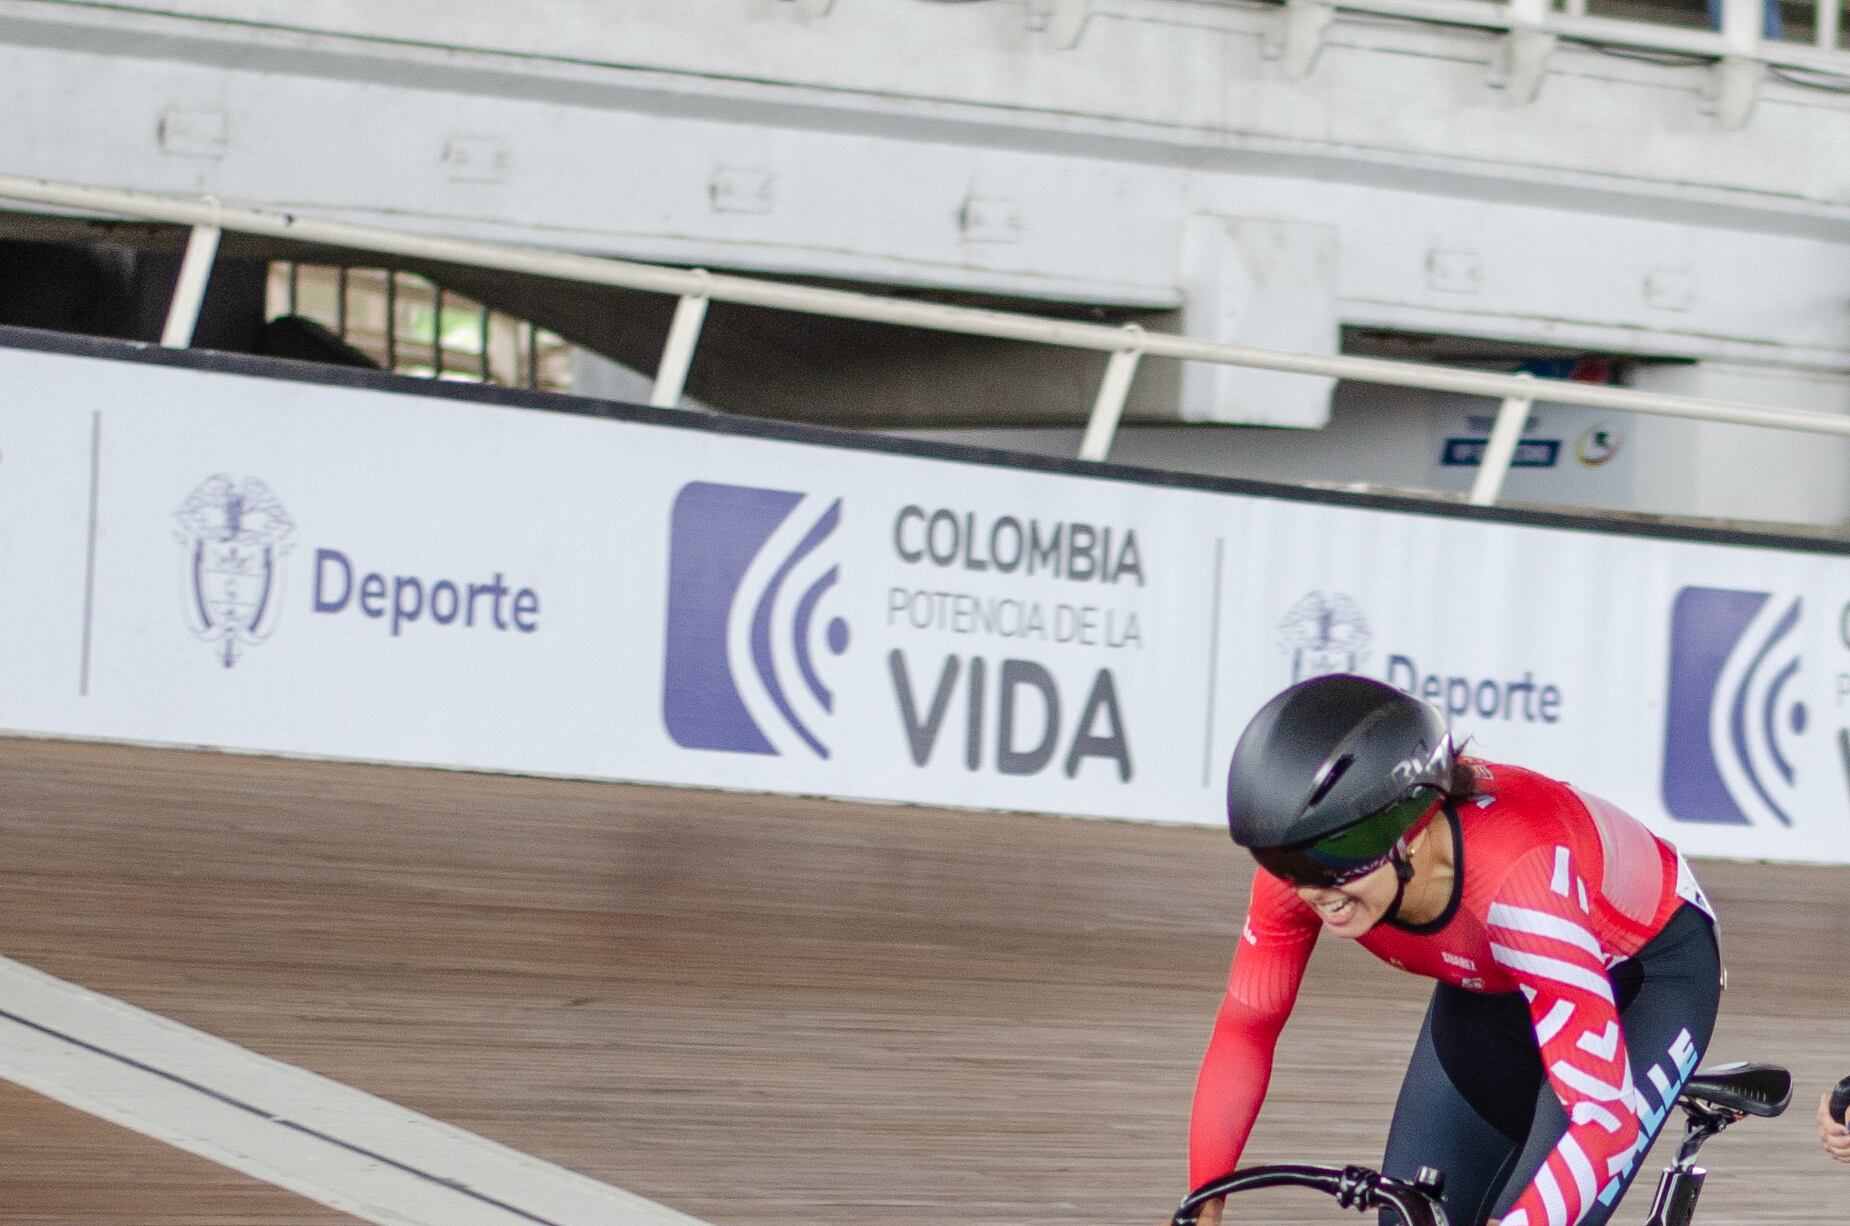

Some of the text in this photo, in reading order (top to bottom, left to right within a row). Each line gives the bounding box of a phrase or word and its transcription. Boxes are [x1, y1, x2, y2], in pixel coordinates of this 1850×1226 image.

[893, 505, 1145, 586] COLOMBIA
[311, 547, 541, 636] Deporte
[888, 587, 1144, 650] POTENCIA DE LA
[888, 649, 1133, 784] VIDA
[1387, 654, 1561, 729] Deporte
